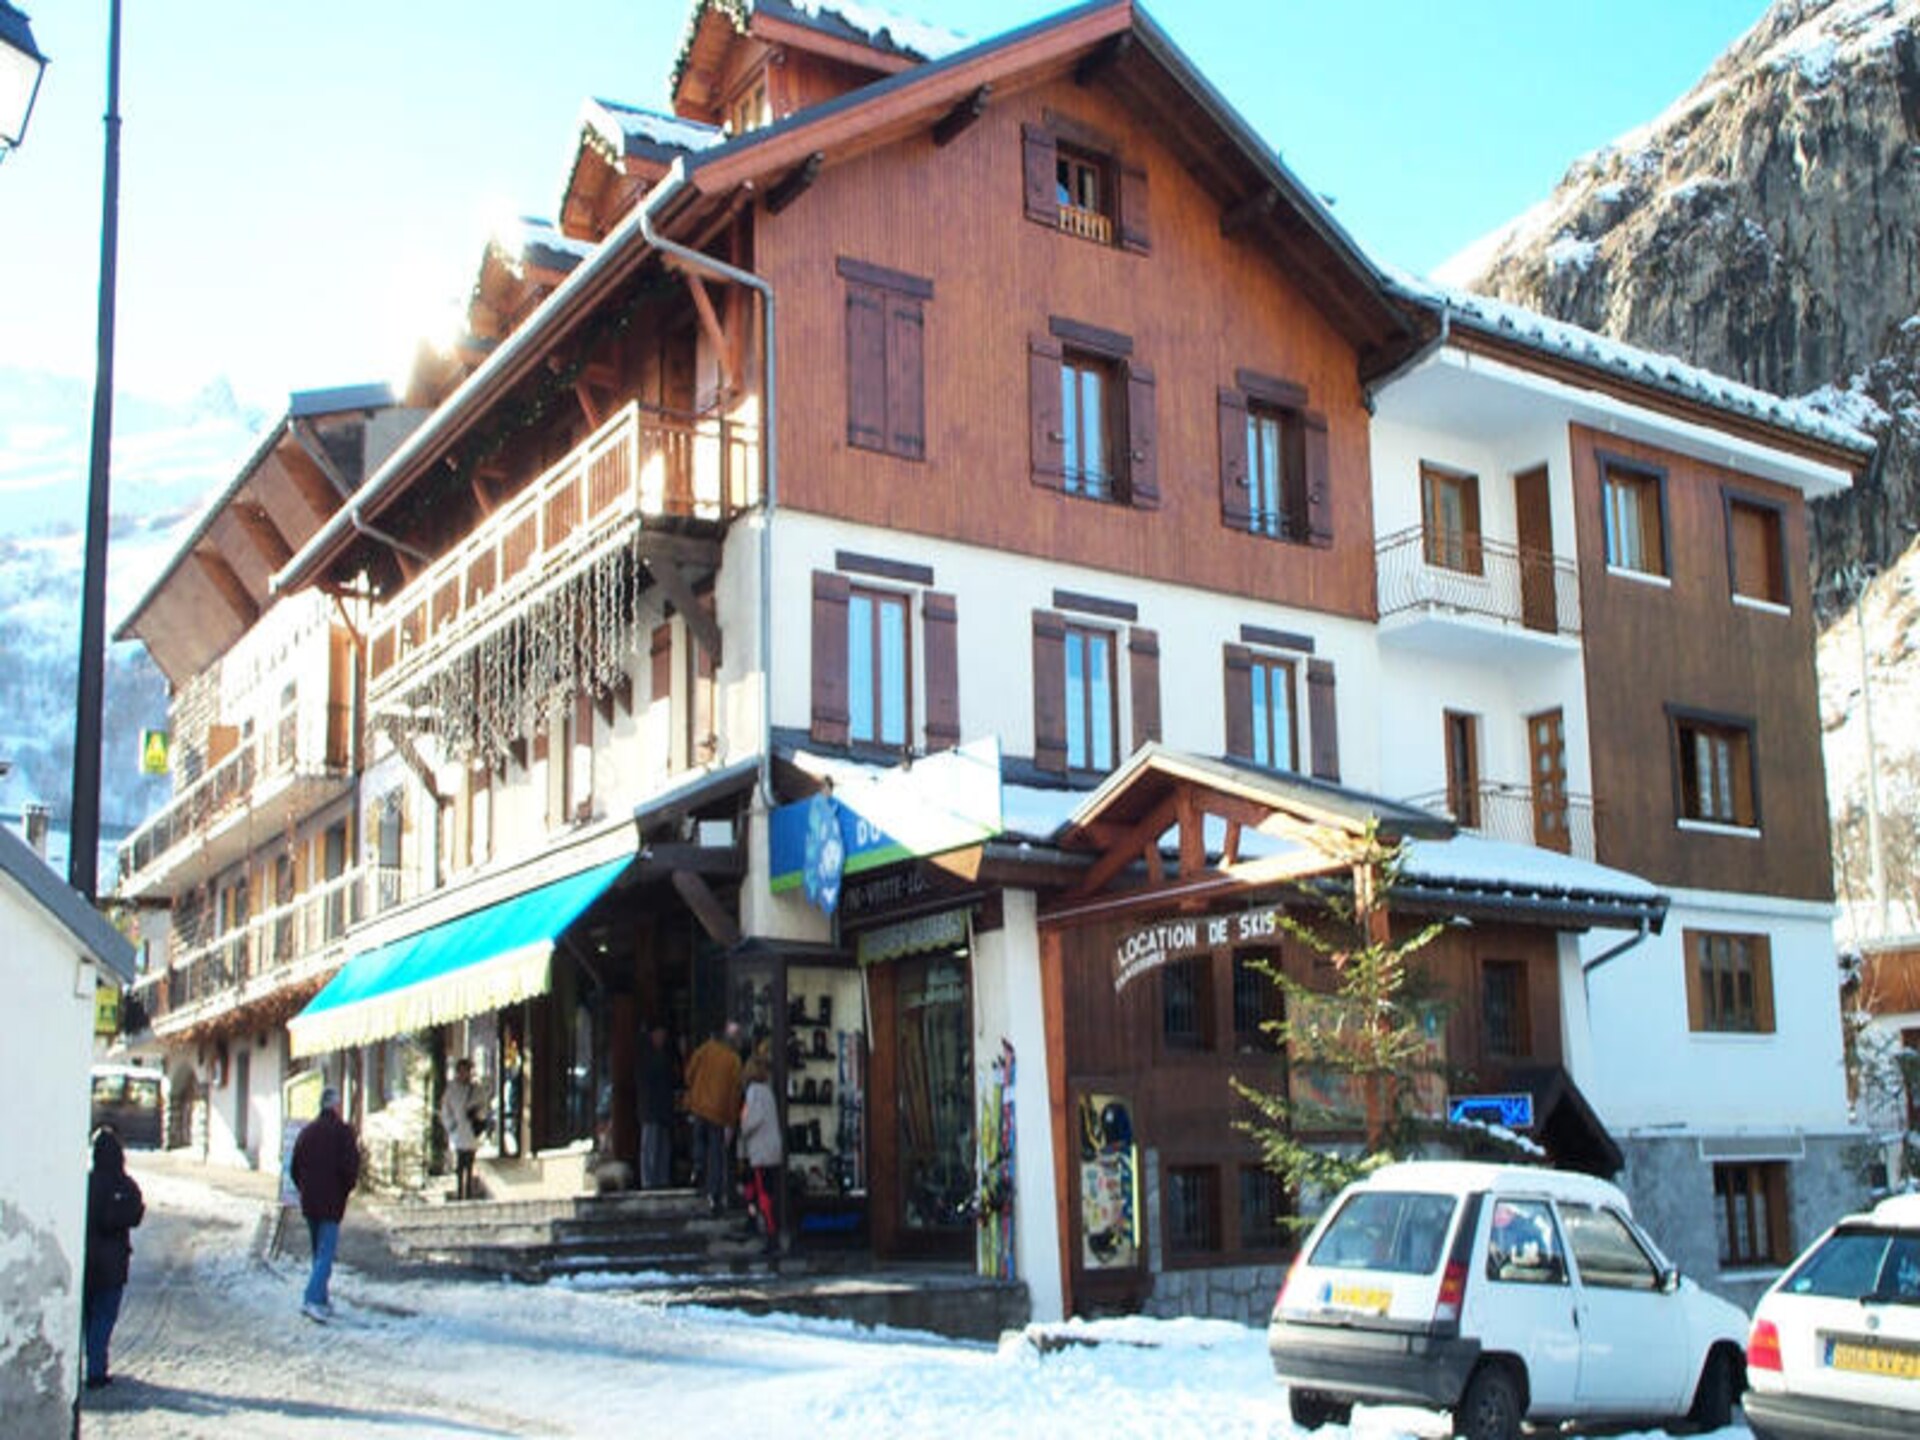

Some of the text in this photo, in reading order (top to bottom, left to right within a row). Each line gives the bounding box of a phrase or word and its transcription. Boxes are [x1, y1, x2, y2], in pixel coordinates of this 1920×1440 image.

[1117, 910, 1276, 967] LOCATION DE SKIS
